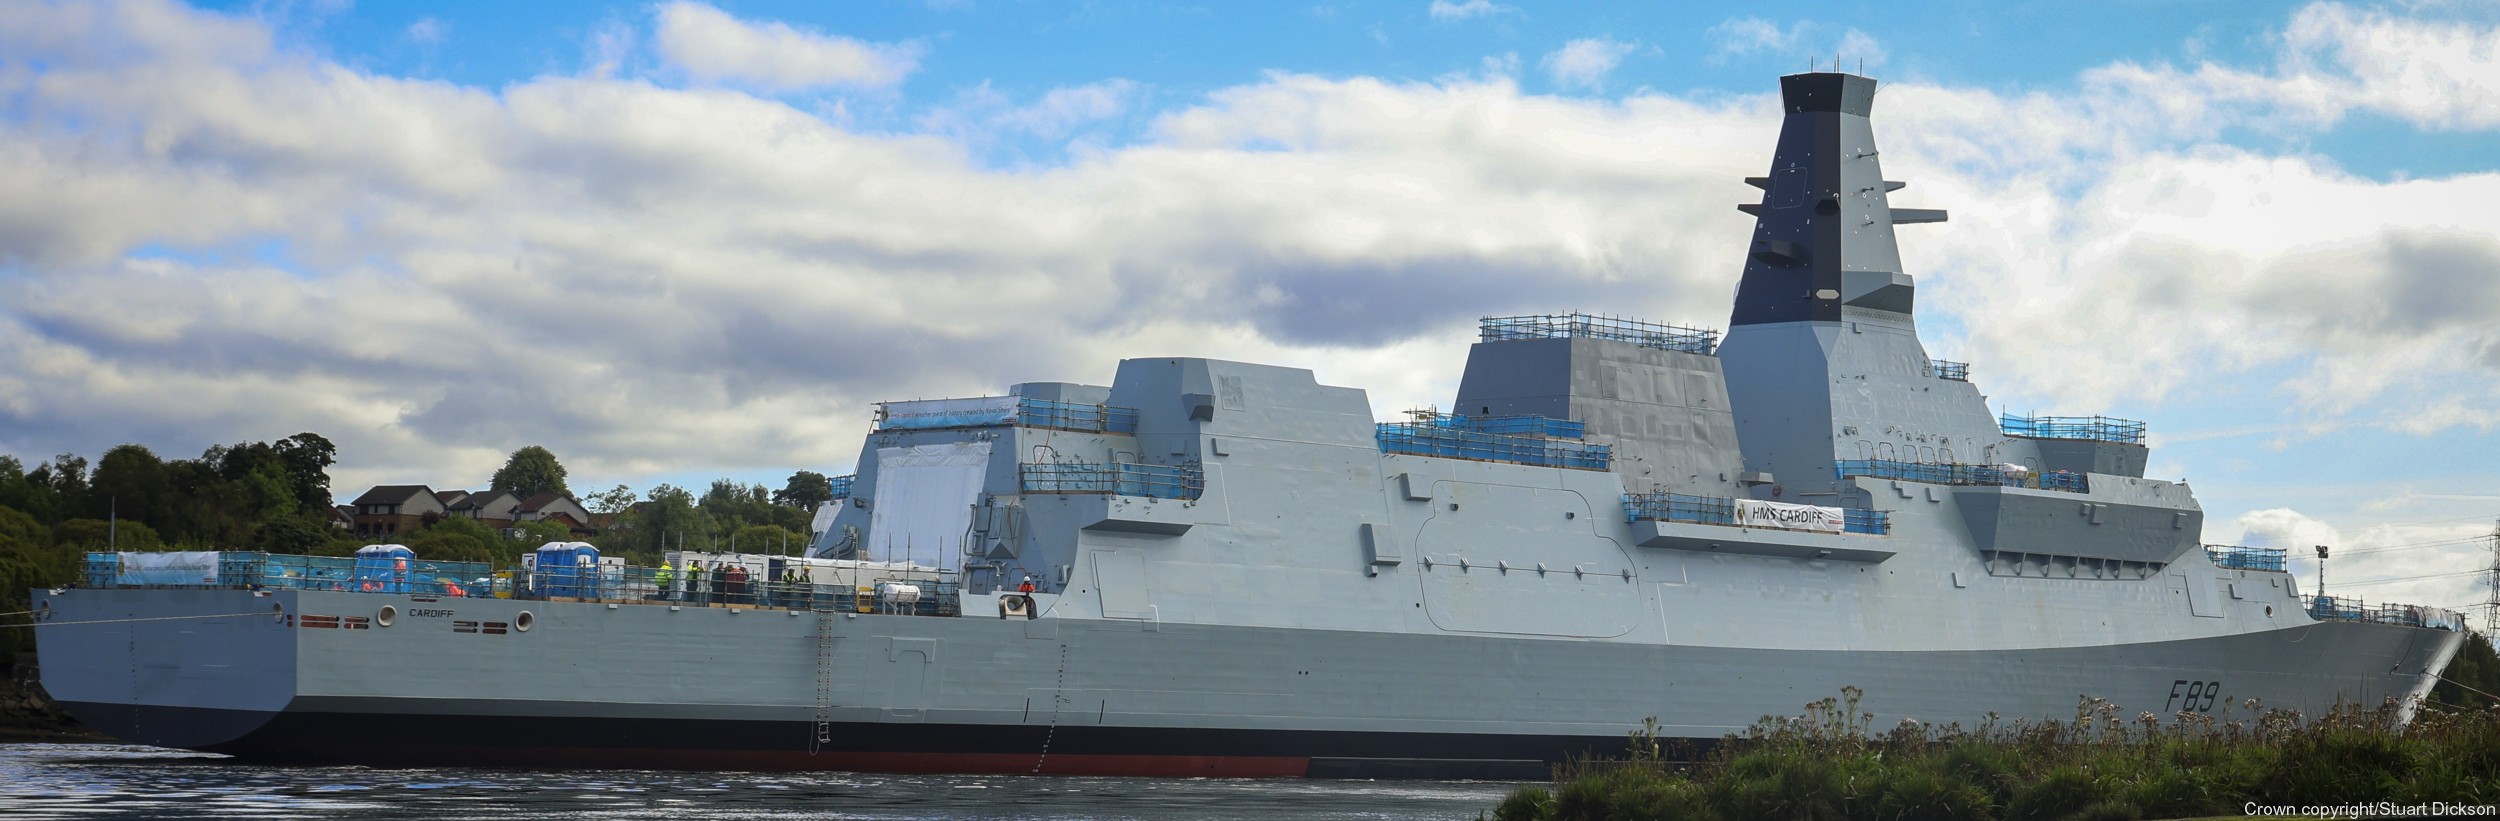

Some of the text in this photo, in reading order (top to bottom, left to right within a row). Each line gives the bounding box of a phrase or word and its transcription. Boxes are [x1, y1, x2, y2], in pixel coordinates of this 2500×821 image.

[1752, 506, 1823, 524] HMS CARDIFF
[409, 608, 454, 618] CARDIFF
[2164, 680, 2220, 712] F89
